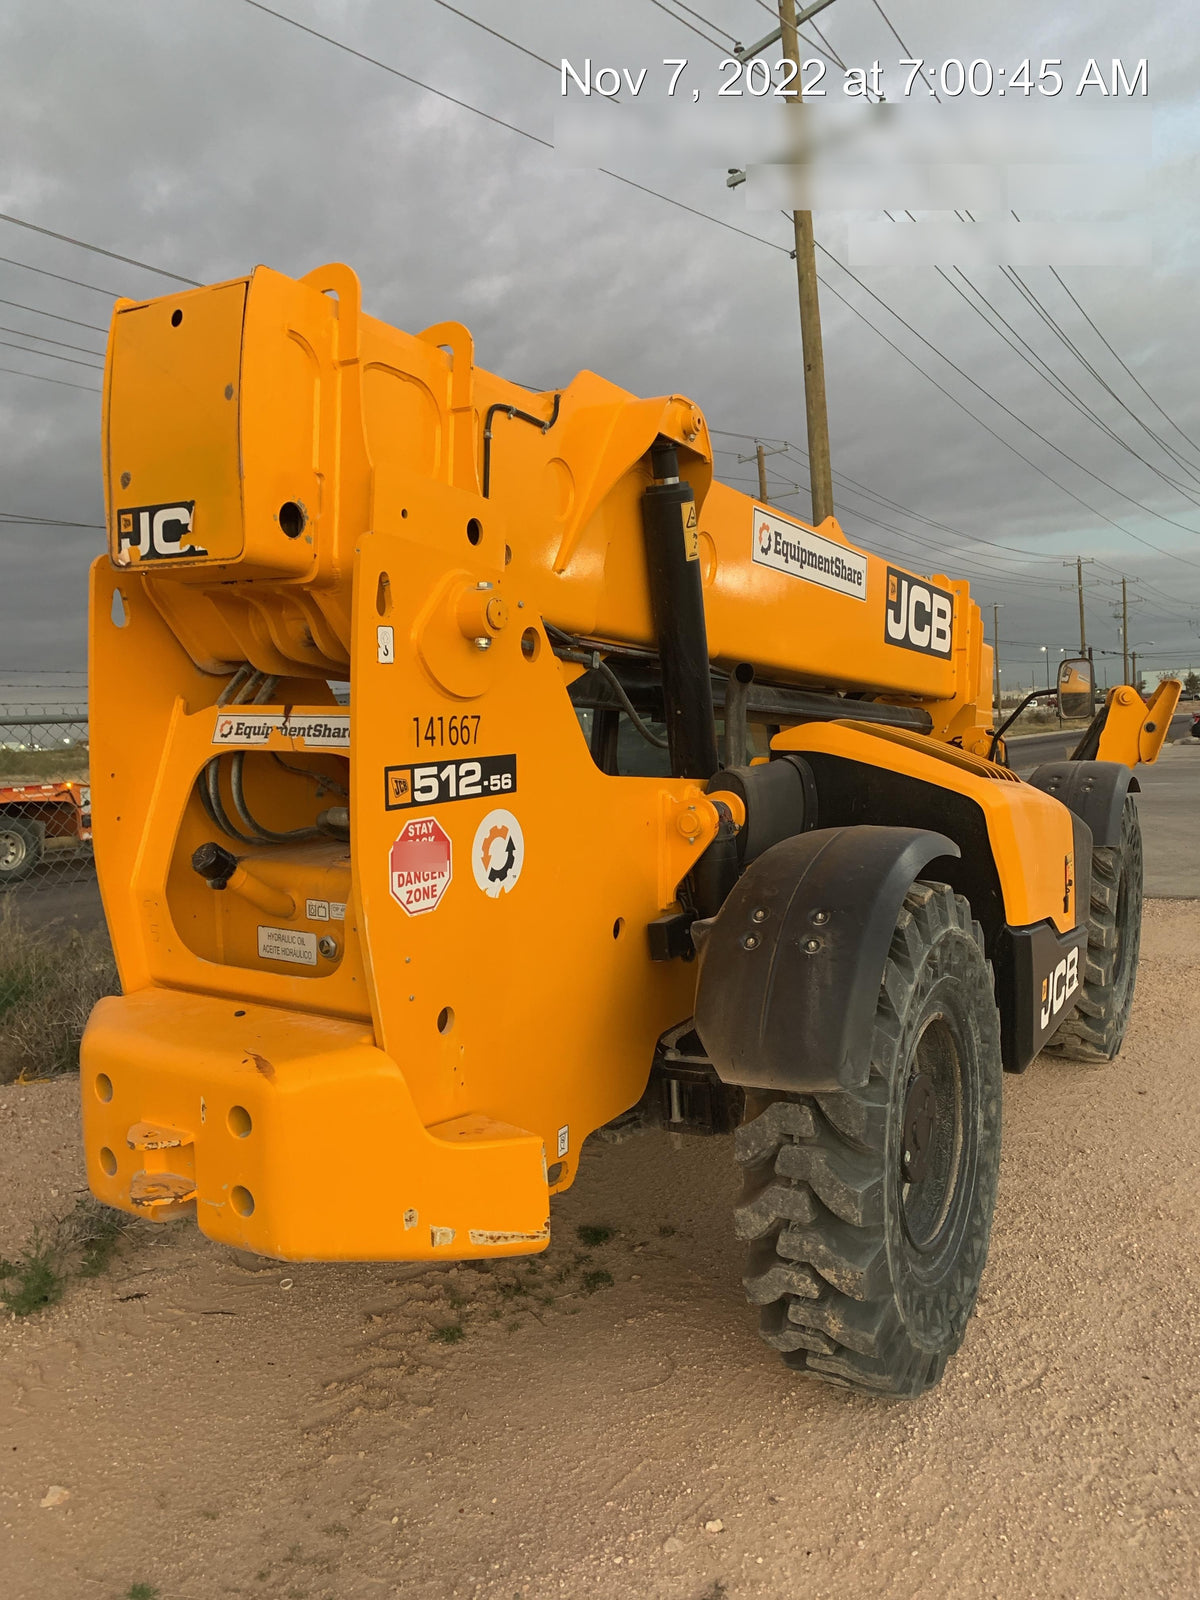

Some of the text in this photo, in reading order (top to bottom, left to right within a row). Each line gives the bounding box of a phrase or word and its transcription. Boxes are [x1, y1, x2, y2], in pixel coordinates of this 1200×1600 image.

[120, 507, 206, 557] JC
[773, 530, 863, 587] EquipmentShare
[887, 580, 952, 653] JCB
[234, 722, 350, 739] EquipmentShar
[412, 715, 481, 748] 141667
[392, 777, 409, 798] JCB
[408, 821, 434, 837] STAY
[405, 884, 438, 905] ZONE
[263, 944, 281, 955] ACEITE
[267, 932, 306, 946] HYDRAULIC OIL
[1041, 946, 1079, 1030] JCB
